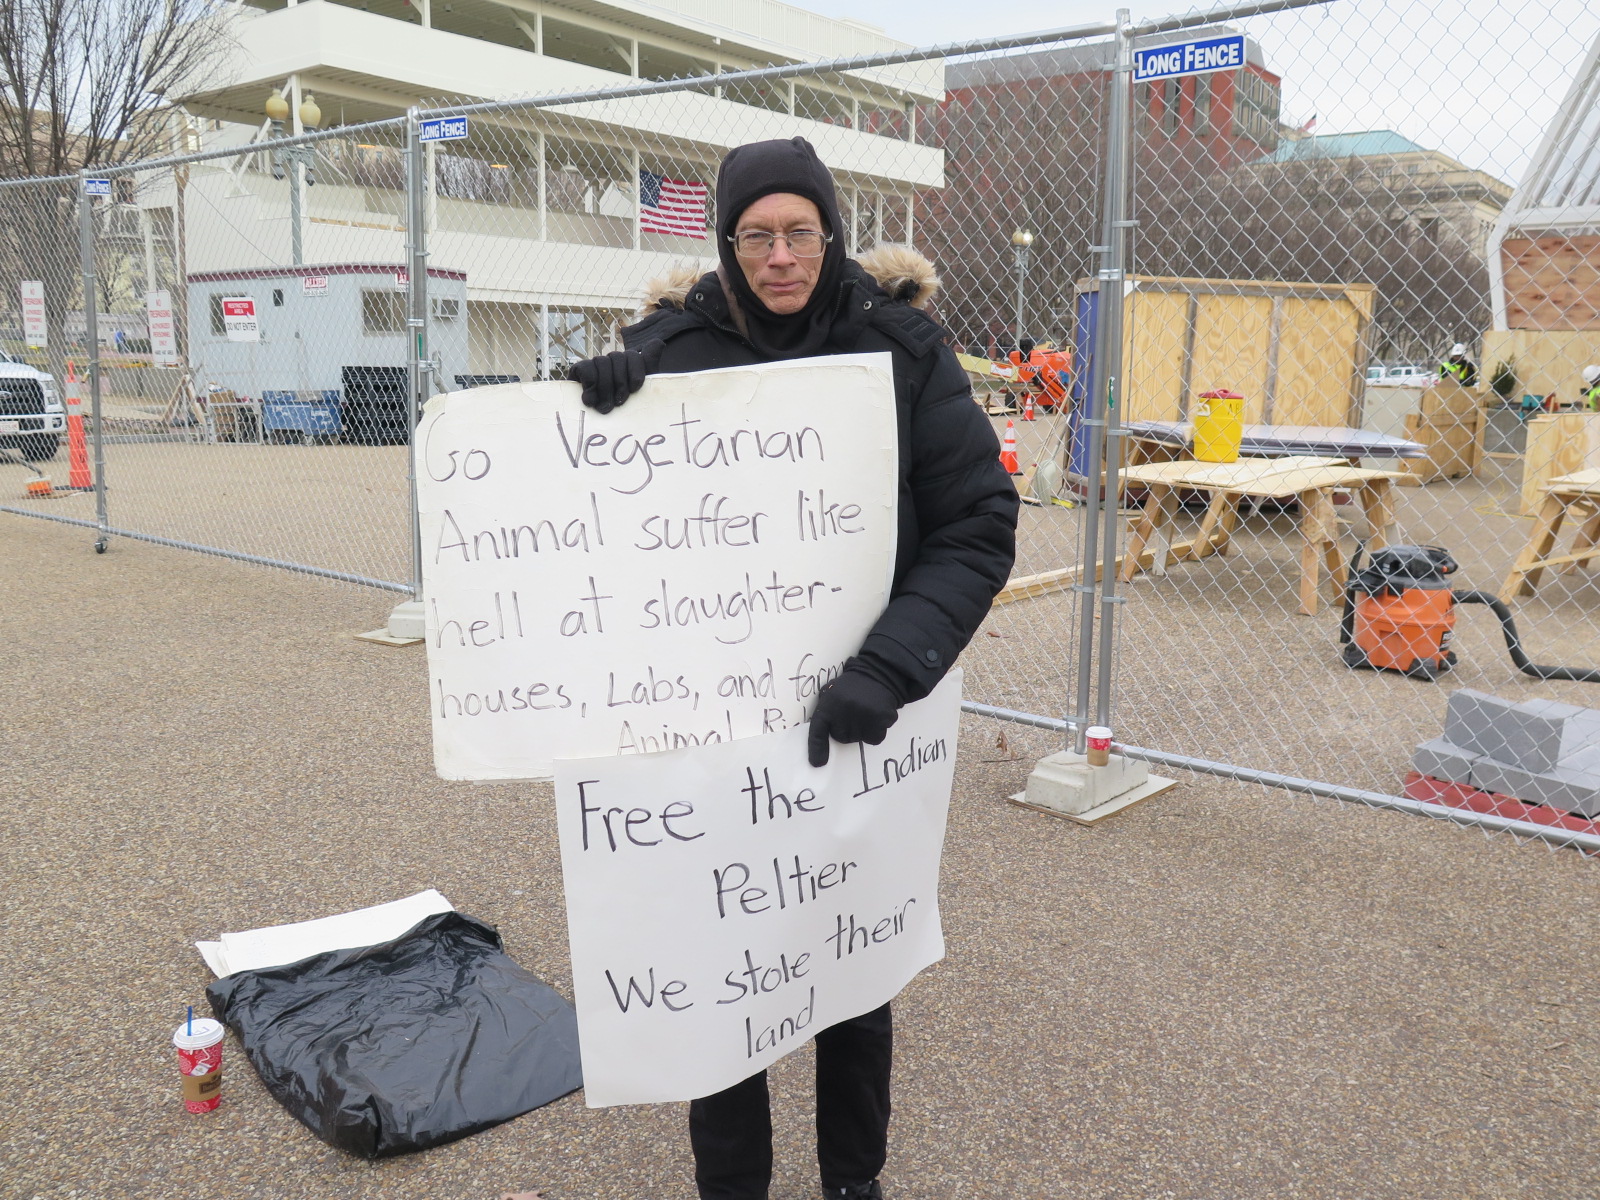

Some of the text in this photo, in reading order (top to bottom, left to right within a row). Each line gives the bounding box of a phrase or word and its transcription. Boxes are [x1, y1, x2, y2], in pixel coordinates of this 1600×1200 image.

[1138, 43, 1240, 77] LONG FENCE
[421, 120, 465, 139] LONG FENCE
[227, 322, 257, 331] DO NOT ENTER
[425, 402, 825, 494] Go Vegetarian
[435, 488, 865, 565] Animal suffer like
[431, 570, 843, 649] hell at slaughter-
[436, 678, 587, 719] houses,
[607, 665, 701, 711] Labs,
[716, 657, 776, 699] and
[617, 709, 733, 756] Animal
[577, 735, 947, 853] Free the Indian
[713, 854, 858, 919] Peltier
[605, 897, 917, 1013] We stole their
[745, 985, 816, 1059] land
